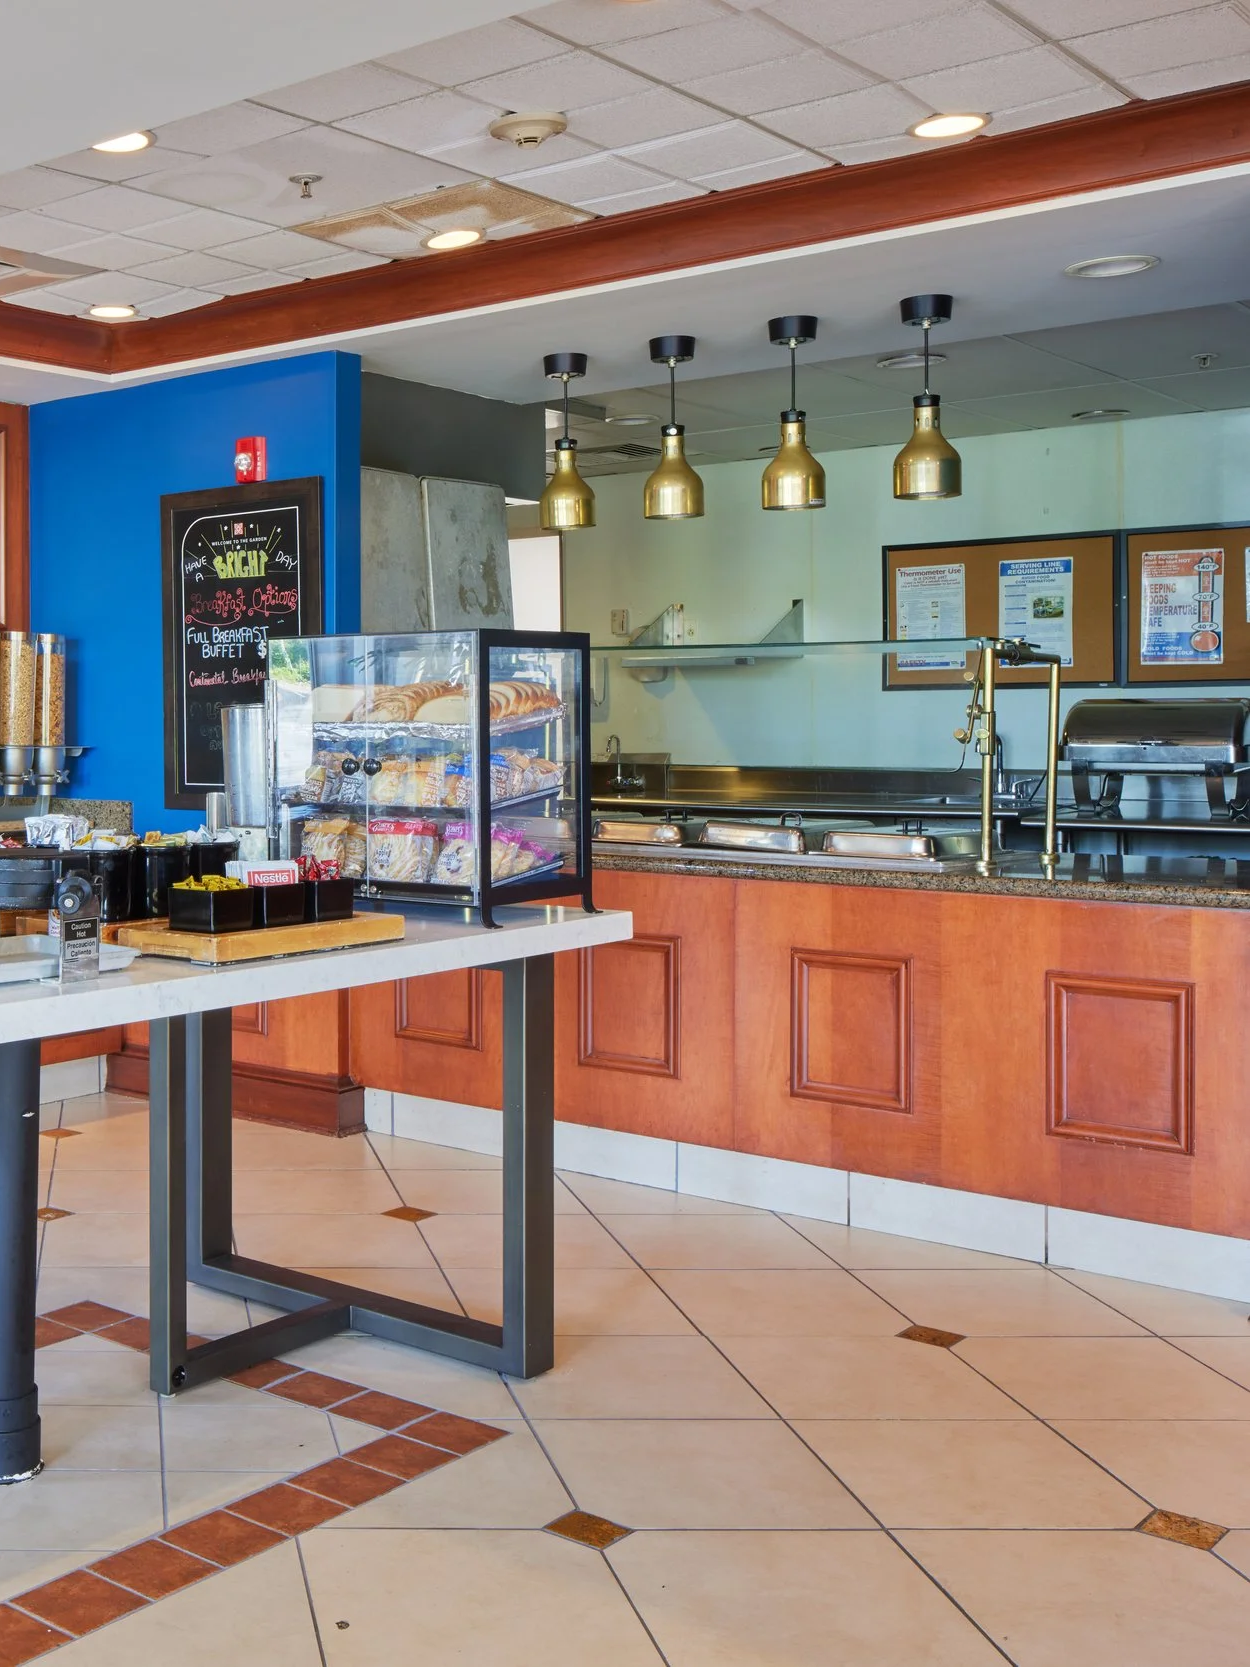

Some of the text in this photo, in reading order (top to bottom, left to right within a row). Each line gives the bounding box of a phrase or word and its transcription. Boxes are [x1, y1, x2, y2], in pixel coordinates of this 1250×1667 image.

[185, 555, 207, 574] HAVE
[213, 549, 269, 579] BRIGHT
[275, 550, 298, 570] DAY
[1007, 567, 1064, 575] REQUIREMENTS
[1010, 562, 1042, 570] SERVING
[195, 572, 204, 582] A
[899, 569, 946, 578] Thermometer
[187, 626, 269, 645] FULL BREAKFAST
[202, 643, 245, 659] BUFFET
[231, 667, 267, 686] Breakfa
[71, 922, 92, 931] Caution
[67, 940, 96, 950] Precaución
[71, 949, 92, 957] Caliente
